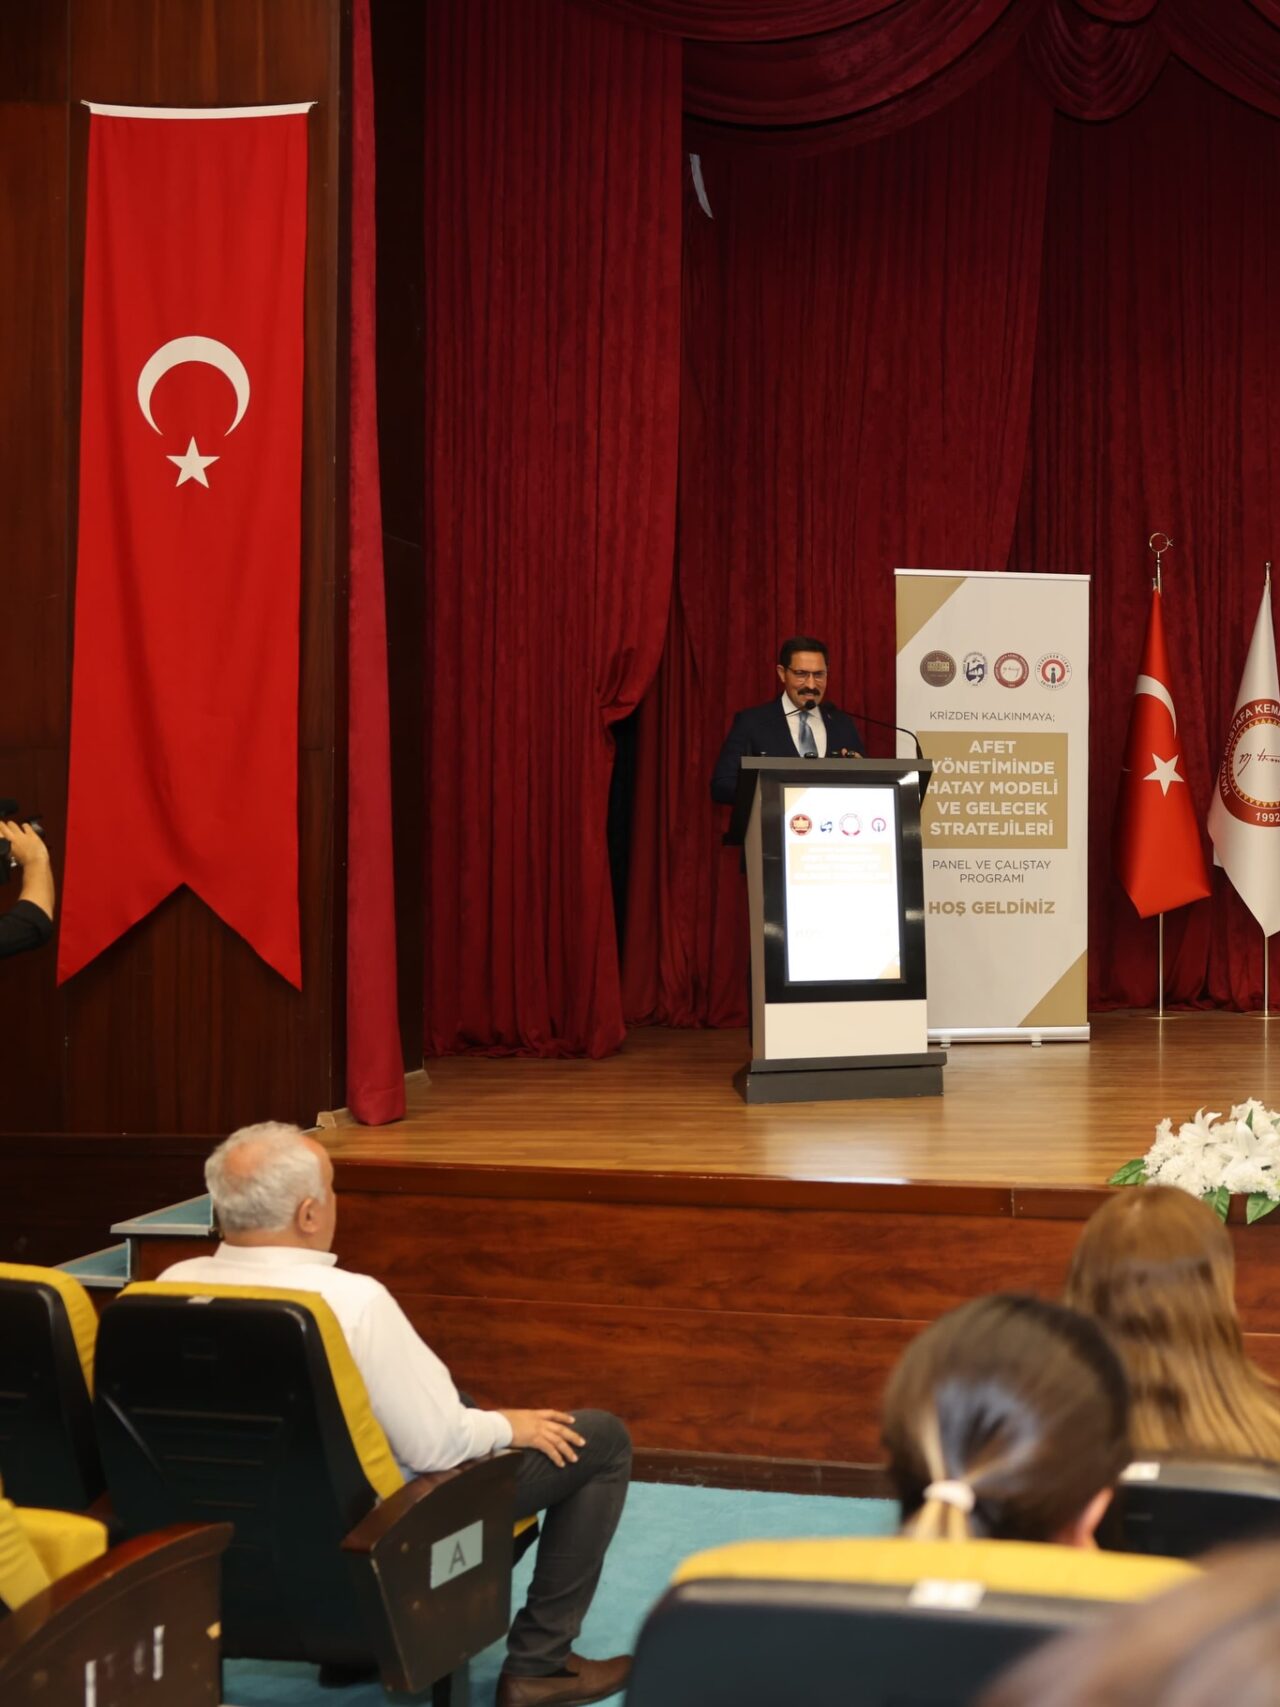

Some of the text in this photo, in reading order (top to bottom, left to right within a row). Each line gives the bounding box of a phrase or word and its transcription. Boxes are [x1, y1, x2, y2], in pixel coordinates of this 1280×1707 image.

[929, 710, 979, 721] KRİZDEN
[969, 740, 1016, 754] AFET
[932, 757, 1055, 775] YÖNETİMİNDE
[927, 778, 1058, 795] HATAY MODELİ
[936, 801, 1048, 816] VE GELECEK
[1255, 811, 1280, 823] 1992
[930, 819, 1054, 836] STRATEJİLERİ
[932, 859, 1051, 871] PANEL VE ÇALIŞTAY
[959, 873, 1024, 883] PROGRAMI
[928, 898, 1055, 917] HOŞ GELDİNİZ
[448, 1540, 466, 1574] A
